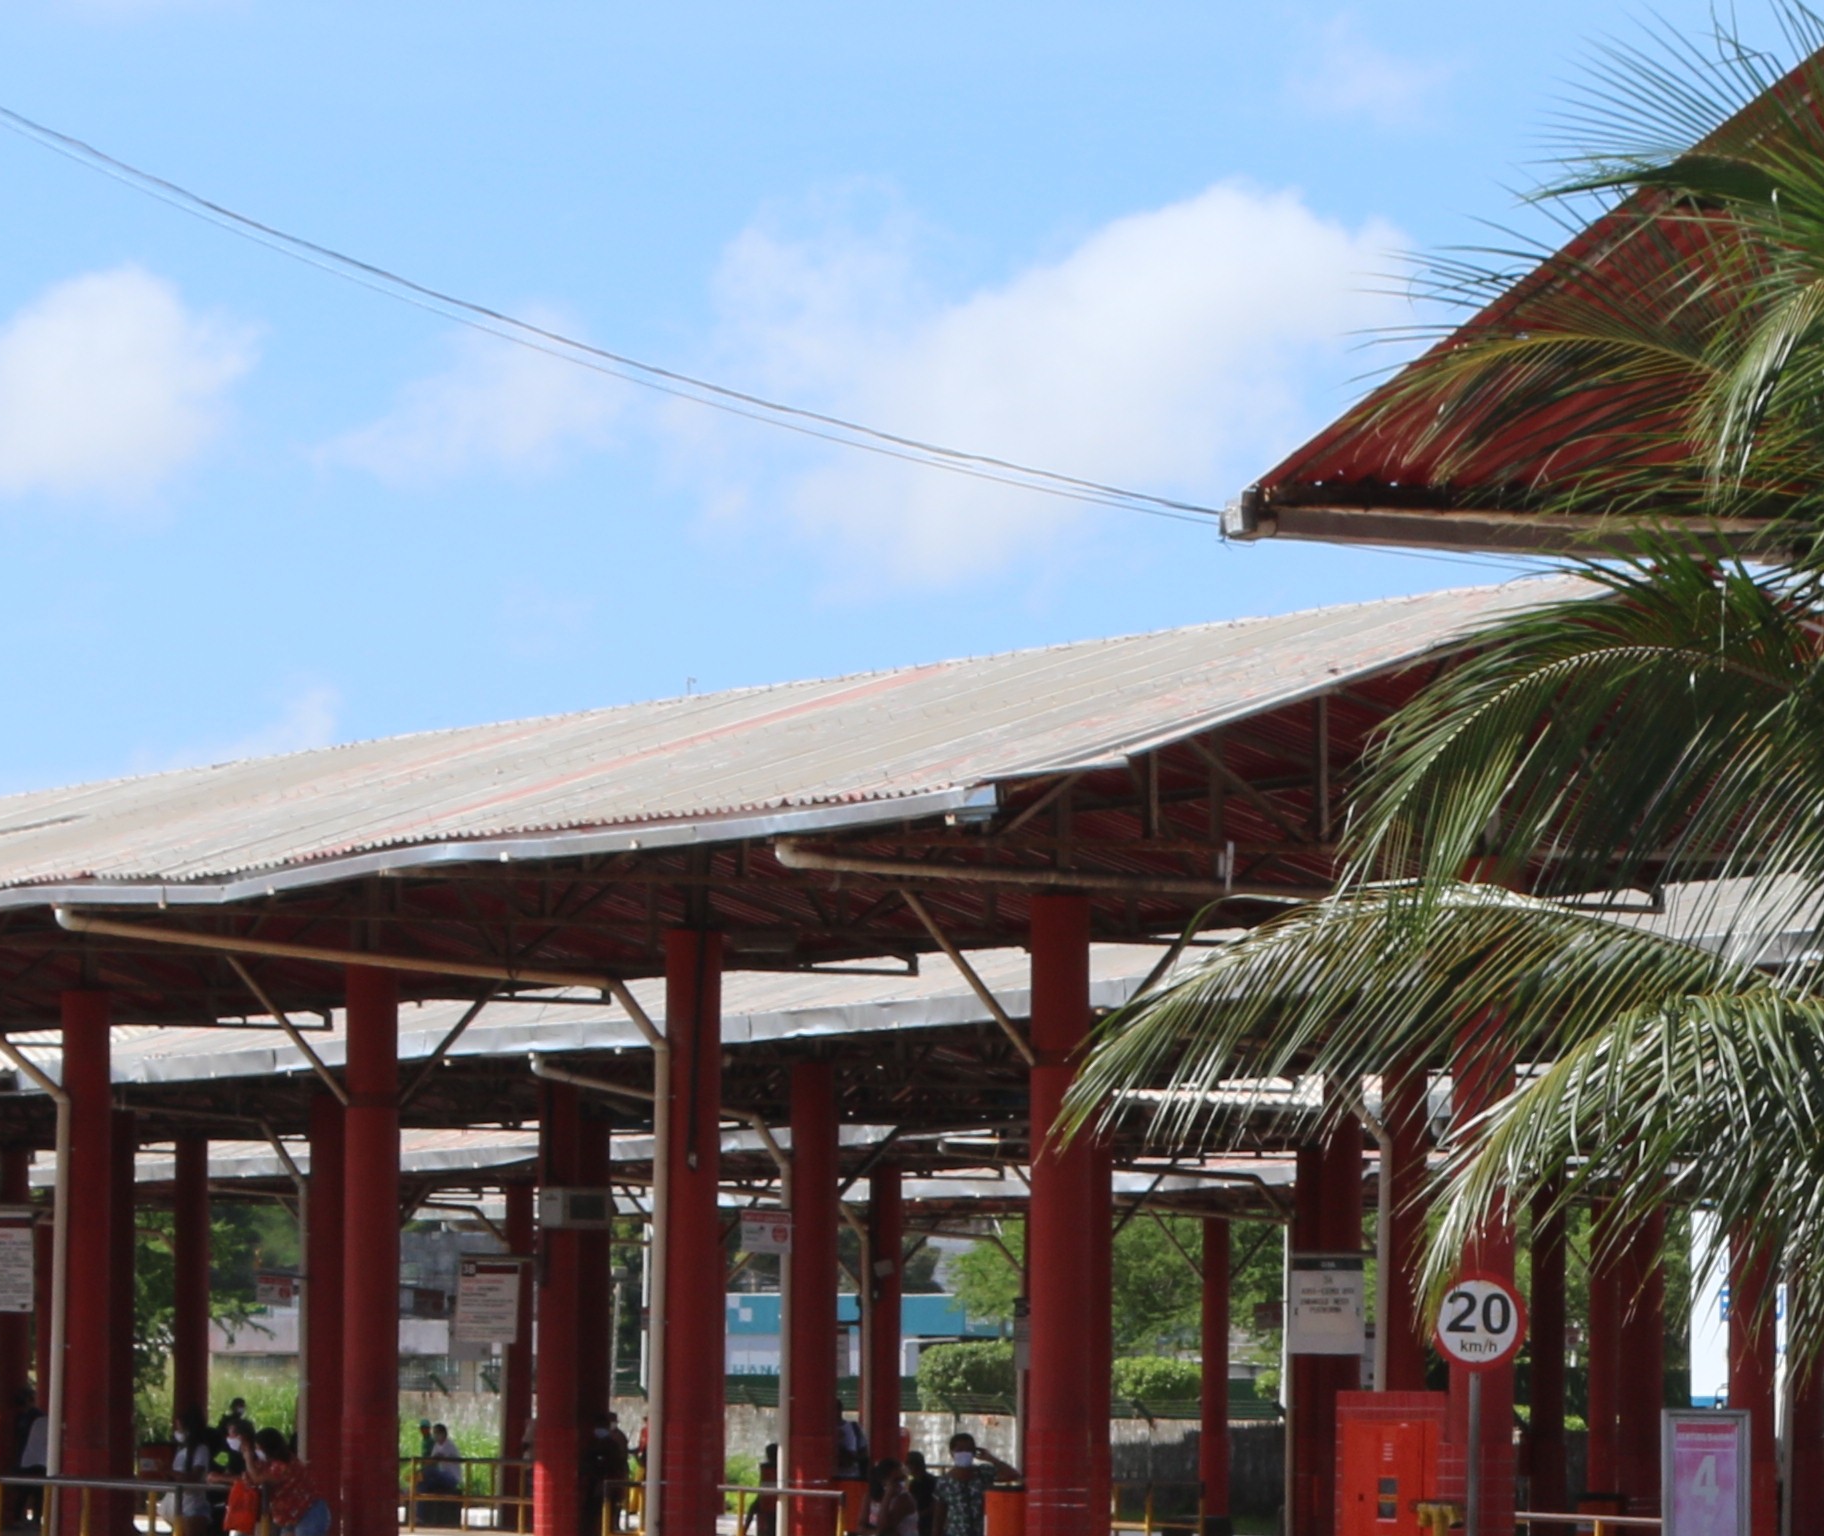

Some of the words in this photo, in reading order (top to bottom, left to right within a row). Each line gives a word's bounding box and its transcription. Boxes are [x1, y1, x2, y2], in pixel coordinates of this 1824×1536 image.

[1446, 1291, 1511, 1335] 20
[1459, 1339, 1498, 1354] km/h
[1690, 1455, 1720, 1506] 4
